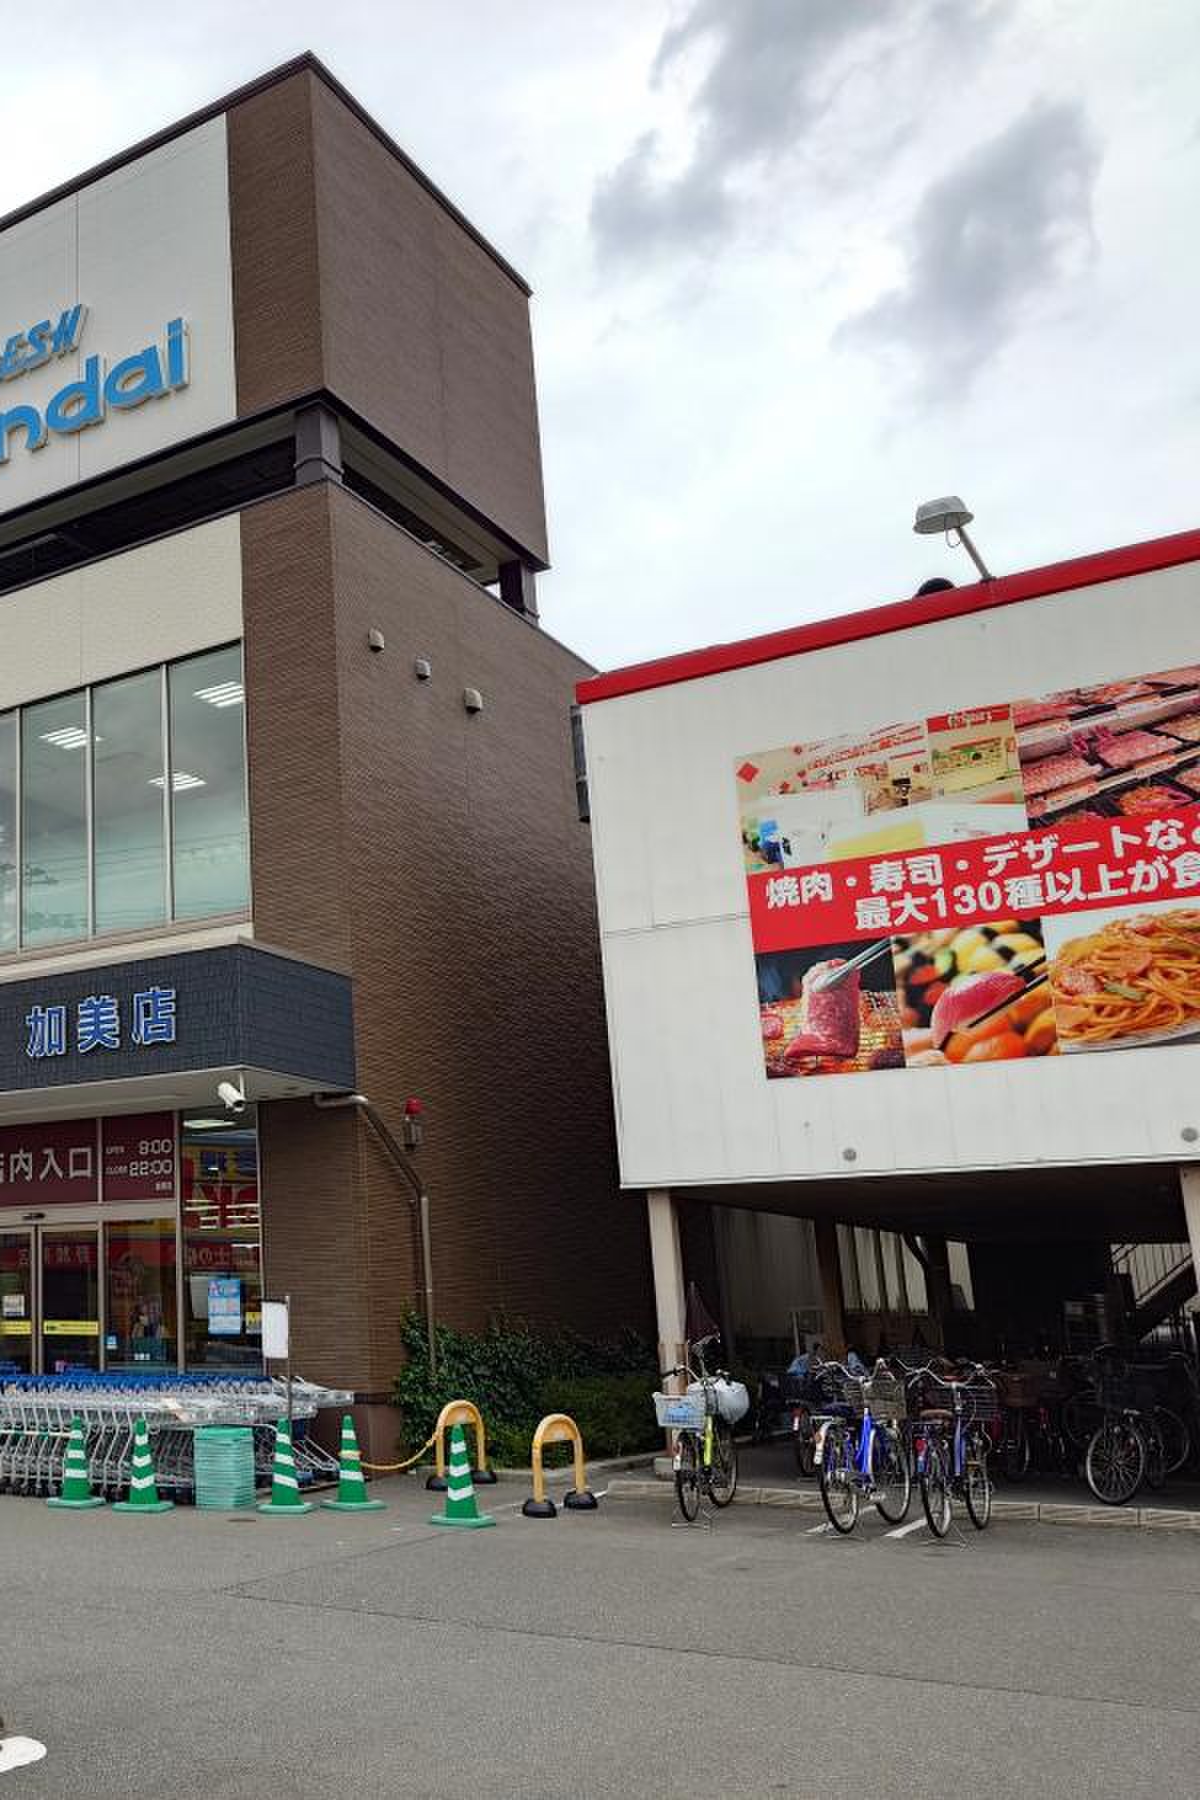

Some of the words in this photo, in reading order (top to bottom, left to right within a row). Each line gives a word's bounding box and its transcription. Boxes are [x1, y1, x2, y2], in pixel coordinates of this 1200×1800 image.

[766, 811, 1200, 909] 焼肉・寿司・デザートな
[24, 986, 178, 1058] 加美店
